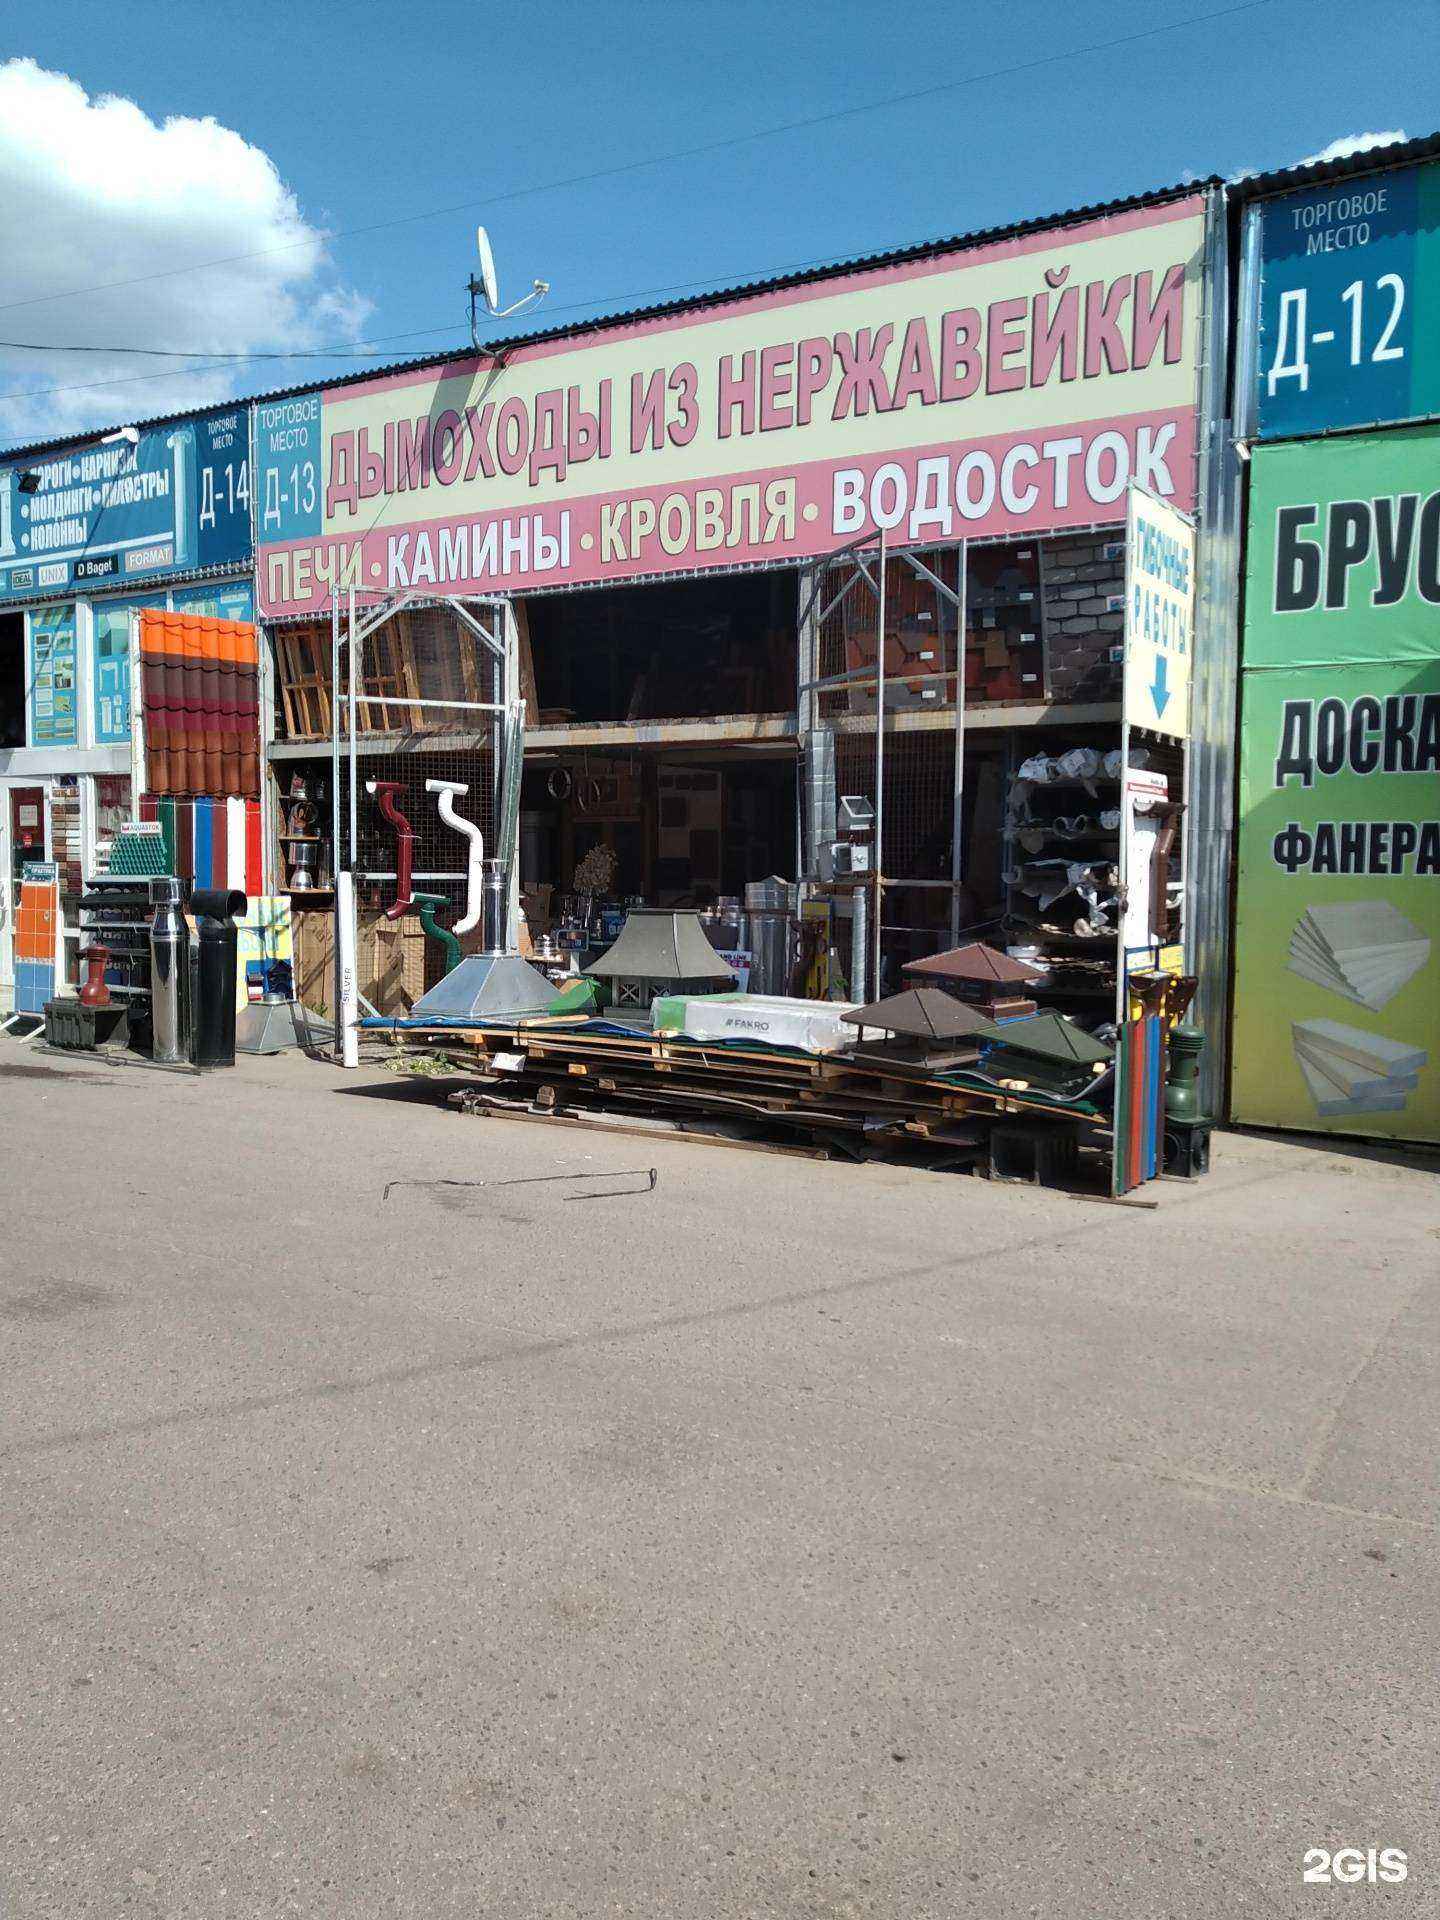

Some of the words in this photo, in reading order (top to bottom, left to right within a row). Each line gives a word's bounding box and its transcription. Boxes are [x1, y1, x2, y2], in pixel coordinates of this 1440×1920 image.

[1293, 189, 1387, 231] ТОРГОВОЕ
[1307, 222, 1370, 256] МЕСТО
[1267, 273, 1405, 397] Д-12
[326, 378, 612, 519] ДЫМОХОДЫ
[630, 361, 699, 454] ИЗ
[717, 262, 1186, 439] НЕРЖАВЕЙКИ
[207, 415, 238, 436] ТОРГОВОЕ
[261, 400, 318, 429] ТОРГОВОЕ
[212, 433, 234, 450] МЕСТО
[270, 427, 308, 453] МЕСТО
[30, 486, 92, 522] МОЛДИНГИ
[200, 460, 250, 531] Д-14
[264, 460, 316, 531] Д-13
[267, 540, 363, 604] ПЕЧИ
[388, 510, 571, 588] КАМИНЫ
[600, 476, 797, 564] КРОВЛЯ
[832, 422, 1177, 540] ВОДОСТОК
[30, 517, 88, 551] КОЛОННЫ
[87, 558, 113, 577] Baget
[129, 547, 170, 568] FORMAT
[1273, 821, 1440, 875] ФАНЕРА
